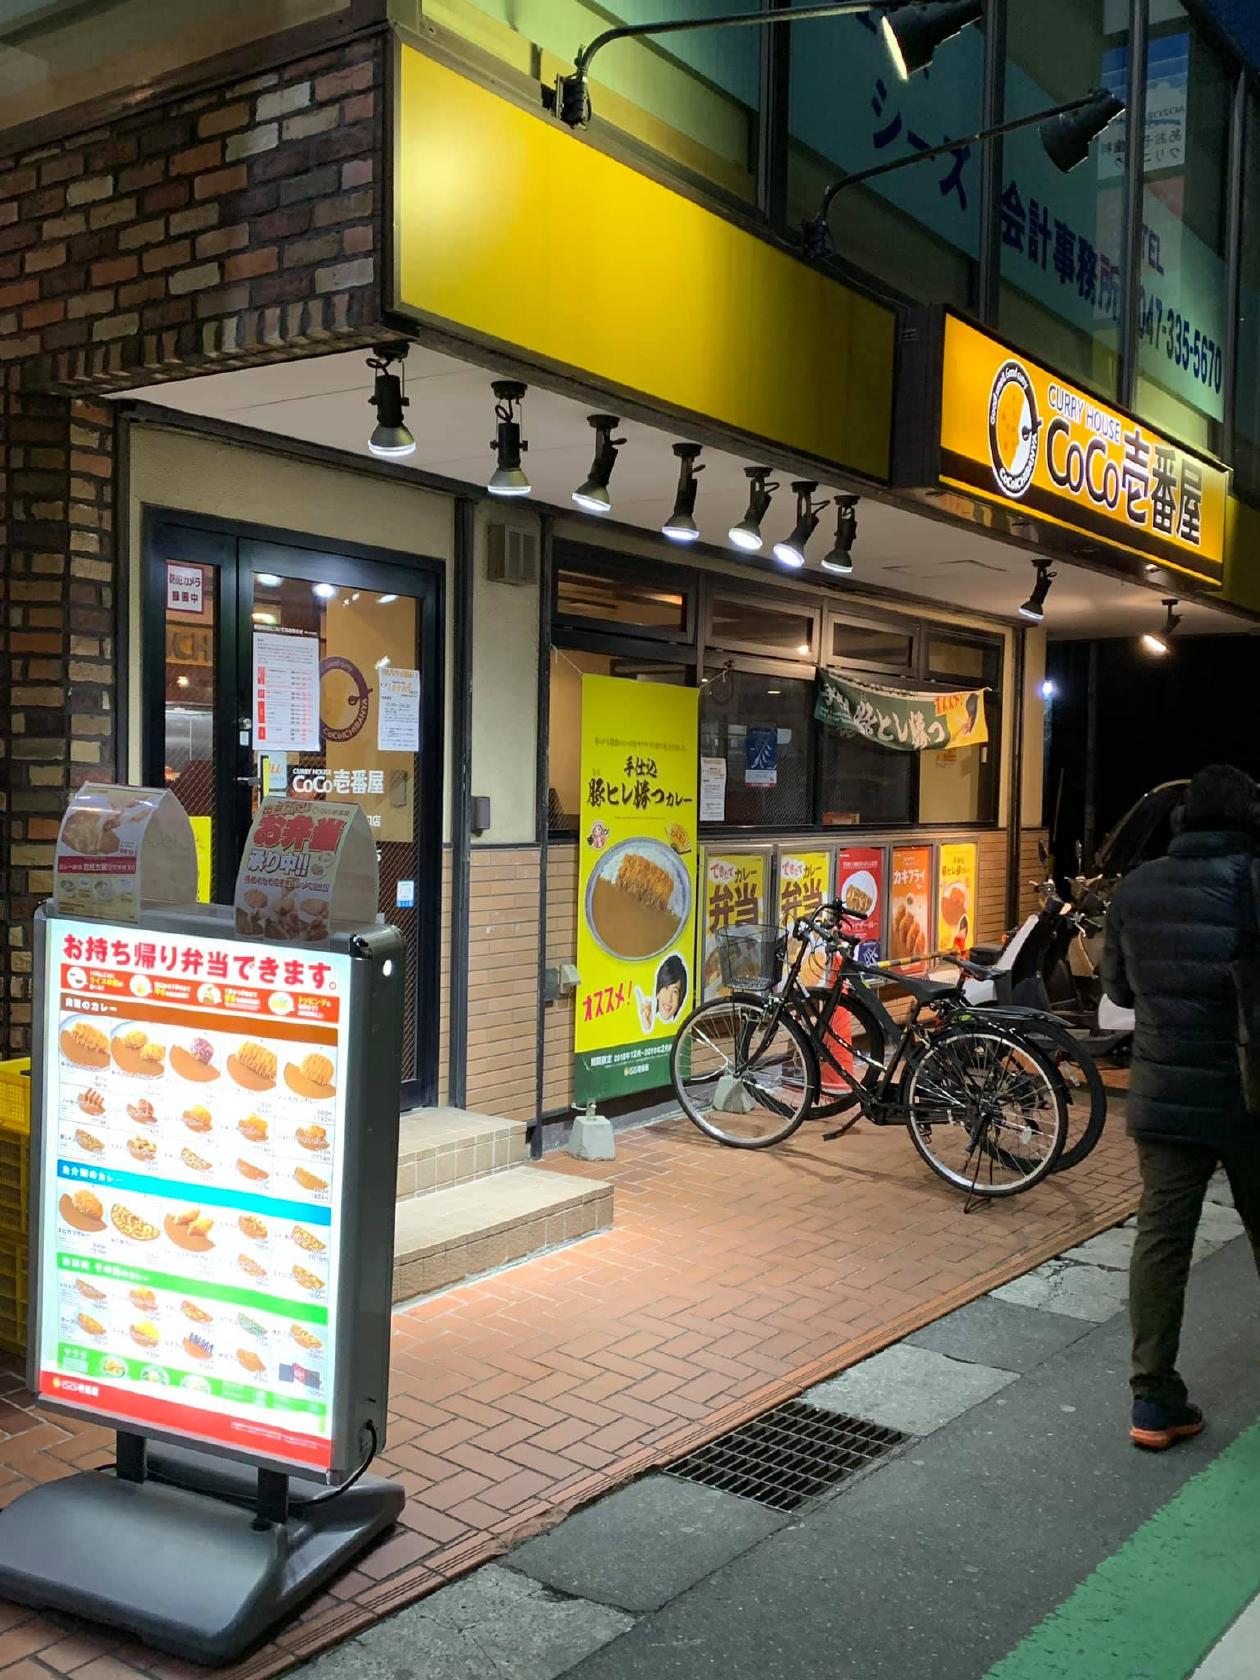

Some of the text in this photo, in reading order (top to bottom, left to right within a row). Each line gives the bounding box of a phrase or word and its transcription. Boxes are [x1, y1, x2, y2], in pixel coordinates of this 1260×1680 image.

[1138, 285, 1222, 394] 047-335-5670
[1048, 384, 1121, 443] CURRY HOUSE
[623, 755, 658, 778] 手仕込
[734, 867, 758, 884] カレー
[803, 864, 823, 879] カレー
[893, 869, 926, 885] カキフライ
[708, 883, 759, 934] 弁当
[62, 933, 337, 991] お持ち帰り弁当できます。
[582, 979, 633, 1023] オススメ!
